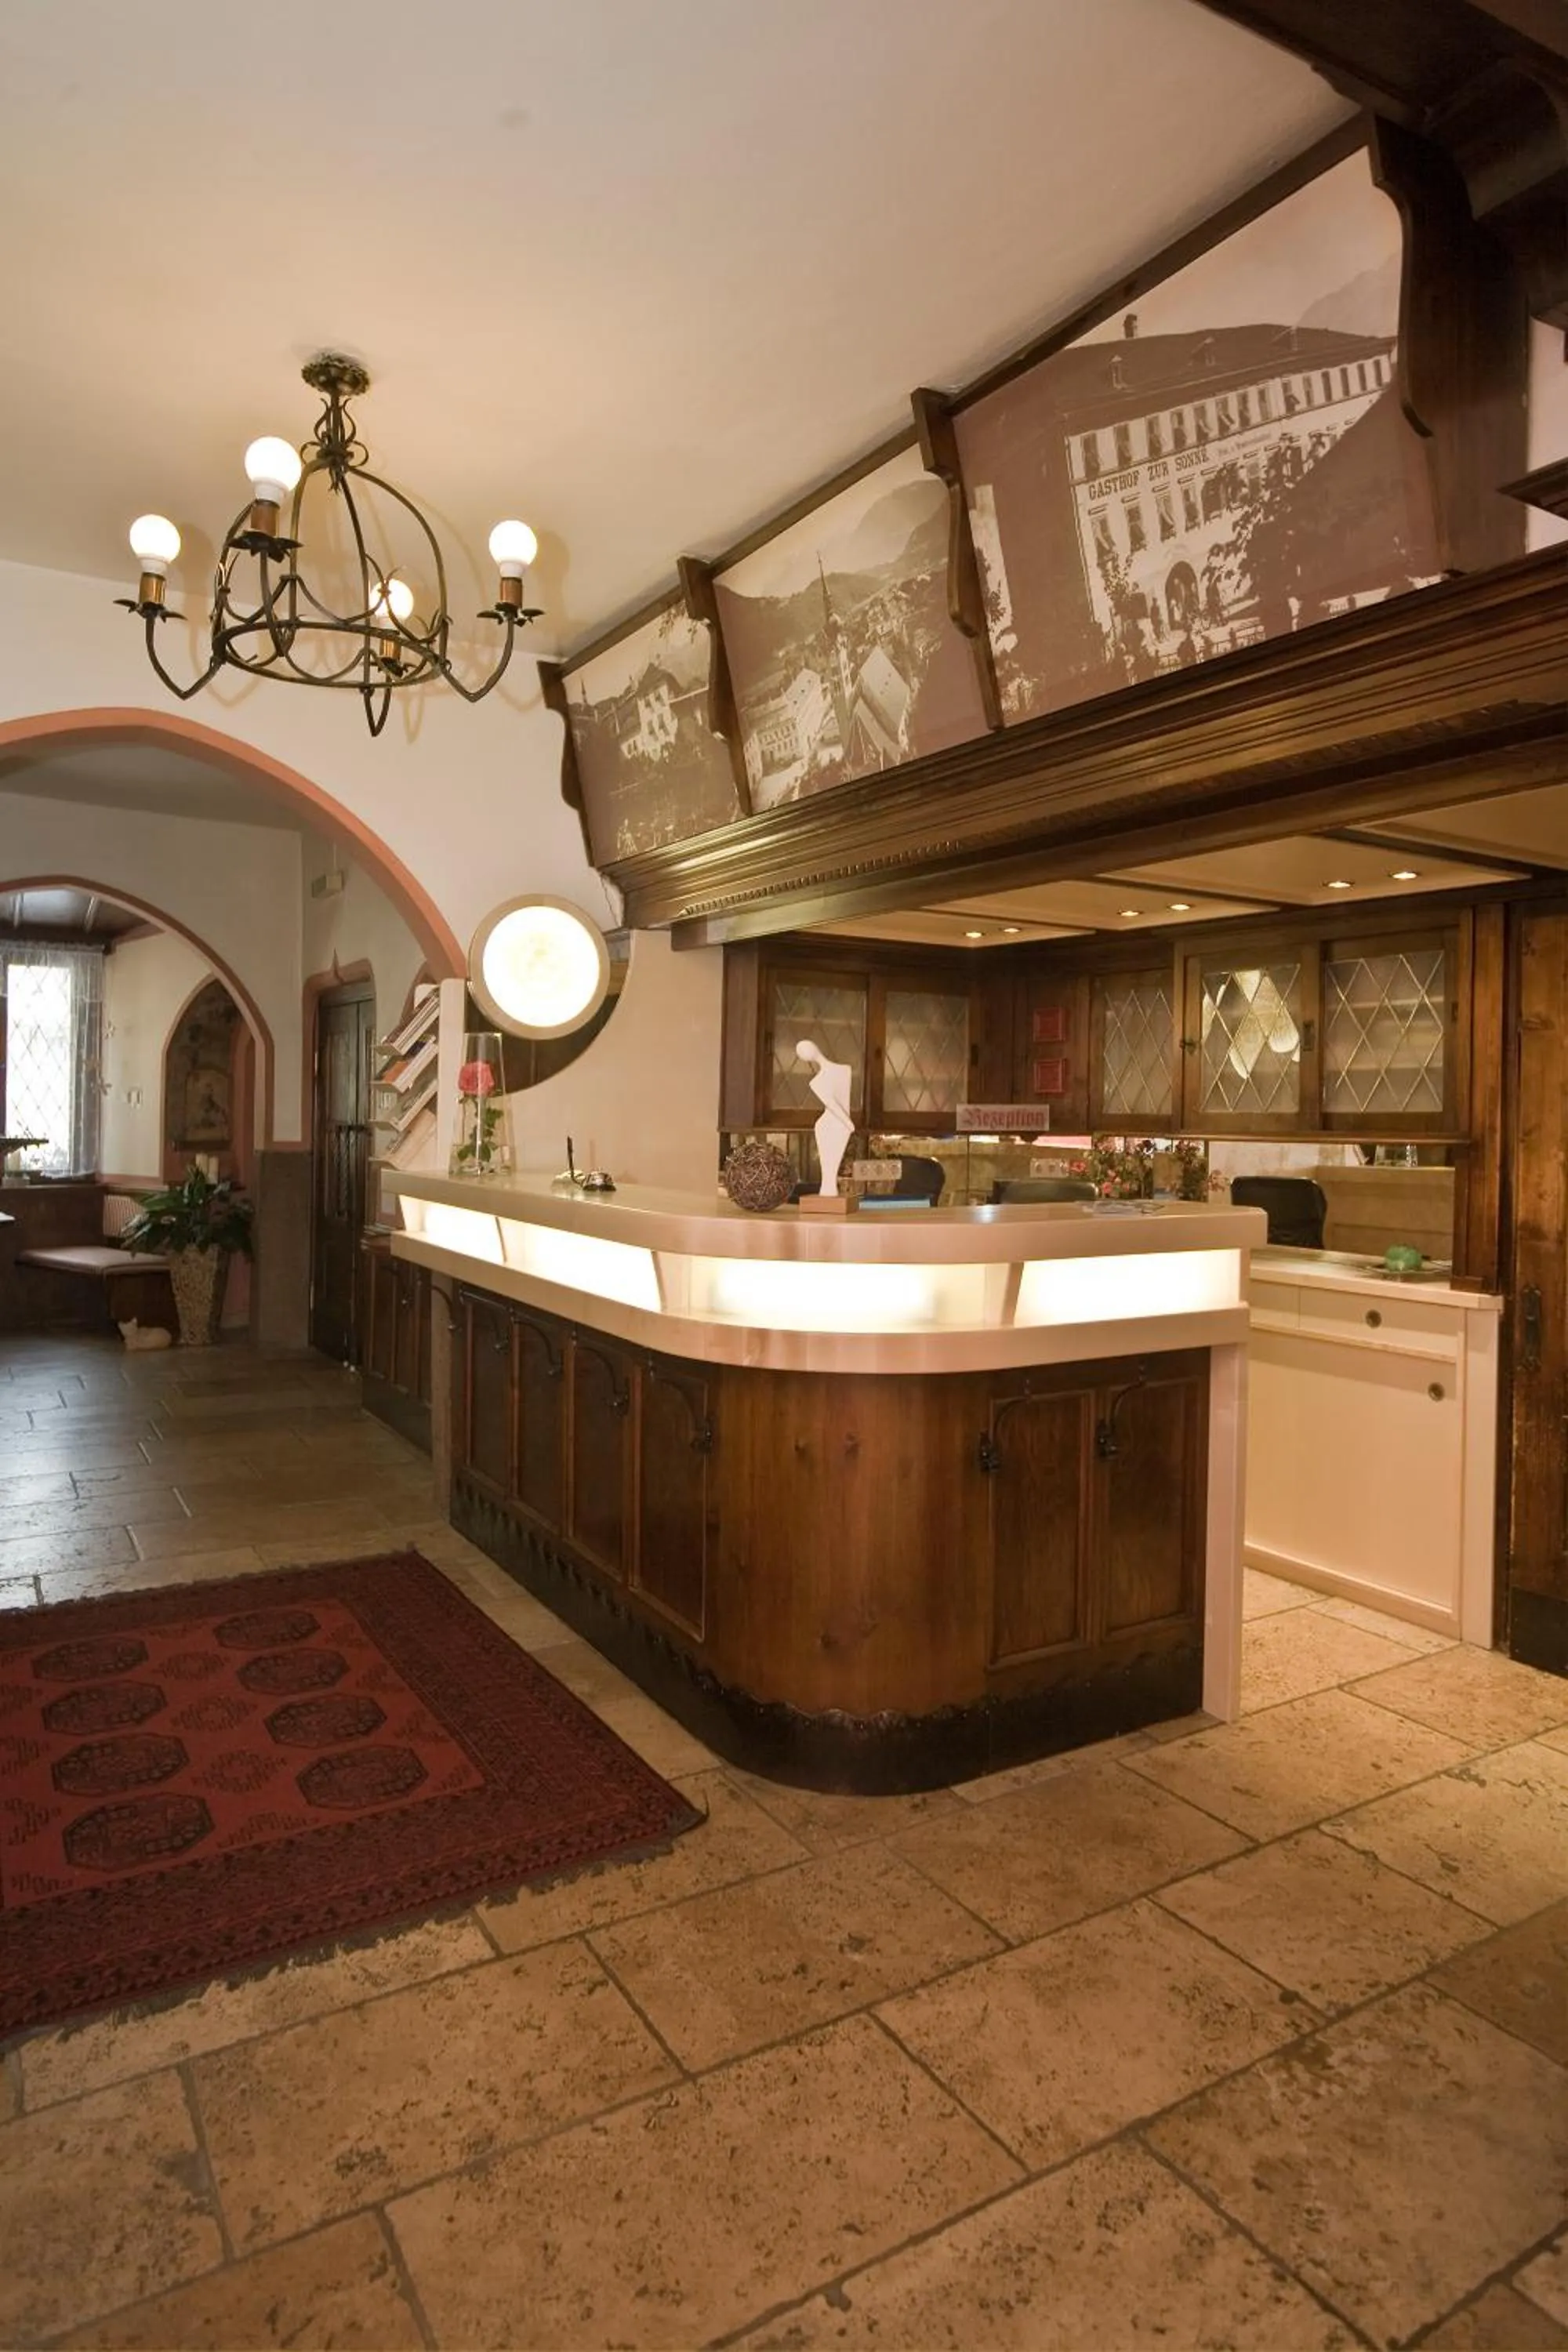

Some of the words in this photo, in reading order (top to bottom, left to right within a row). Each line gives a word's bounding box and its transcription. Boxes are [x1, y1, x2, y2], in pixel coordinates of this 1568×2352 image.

[1088, 470, 1140, 500] GASTHOF
[1147, 461, 1170, 481] ZUR
[1174, 448, 1209, 471] SONNE
[963, 1107, 1045, 1129] Rezeption
